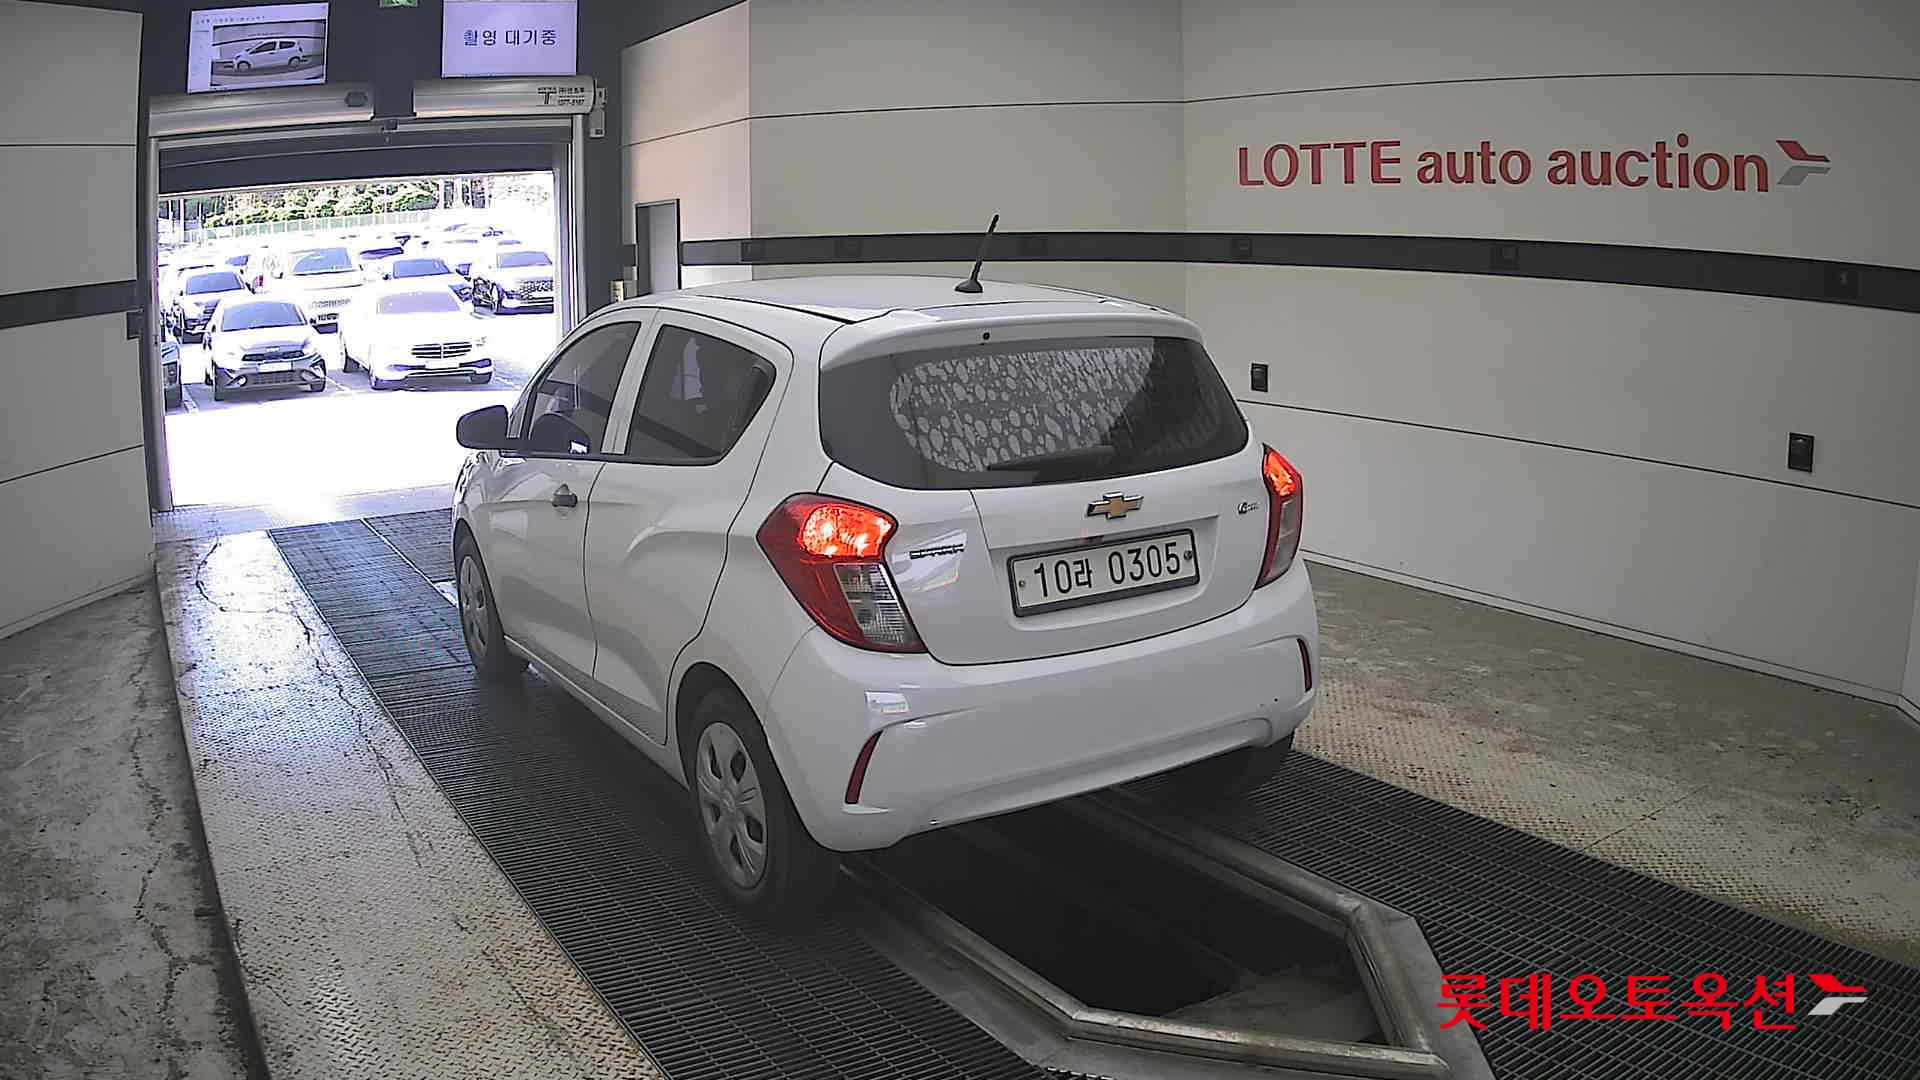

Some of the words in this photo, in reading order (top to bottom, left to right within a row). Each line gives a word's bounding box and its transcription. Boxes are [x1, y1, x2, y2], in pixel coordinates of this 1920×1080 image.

[505, 29, 557, 46] 대기중
[1239, 140, 1400, 187] LOTTE
[1417, 140, 1531, 185] auto
[1547, 133, 1769, 192] auction
[1033, 558, 1093, 598] 10라
[1107, 541, 1181, 585] 0305
